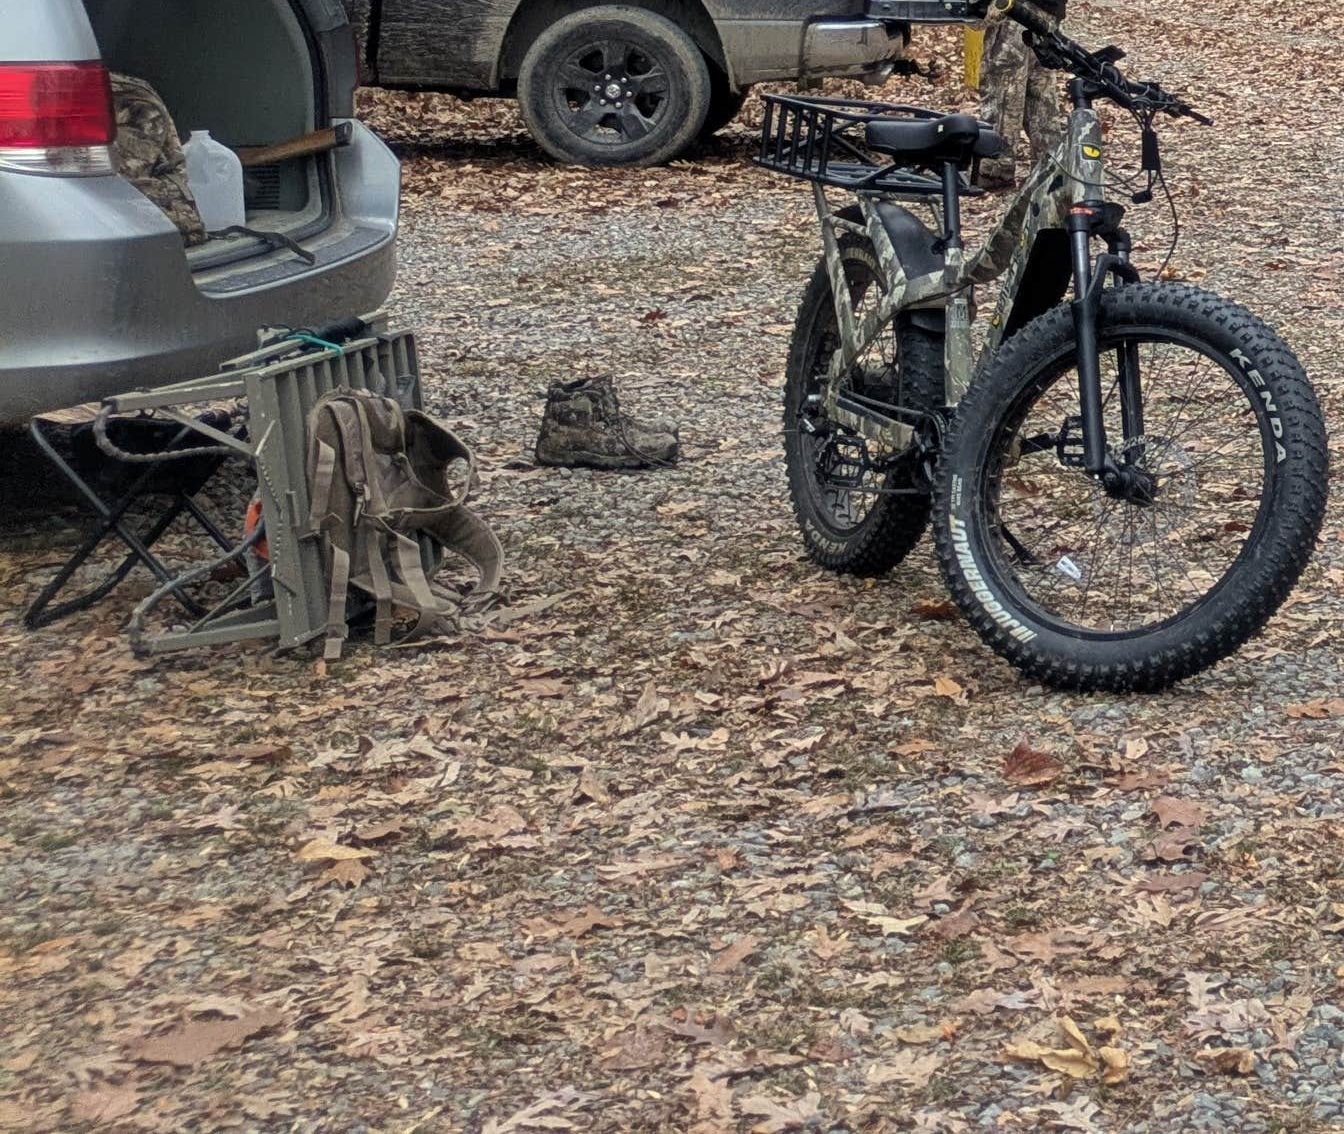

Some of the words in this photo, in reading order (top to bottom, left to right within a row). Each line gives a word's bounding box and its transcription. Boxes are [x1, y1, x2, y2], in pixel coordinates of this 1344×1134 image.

[1229, 348, 1287, 463] KENDA
[805, 518, 849, 555] KENDA
[950, 514, 1022, 632] JUGGERNAUT
